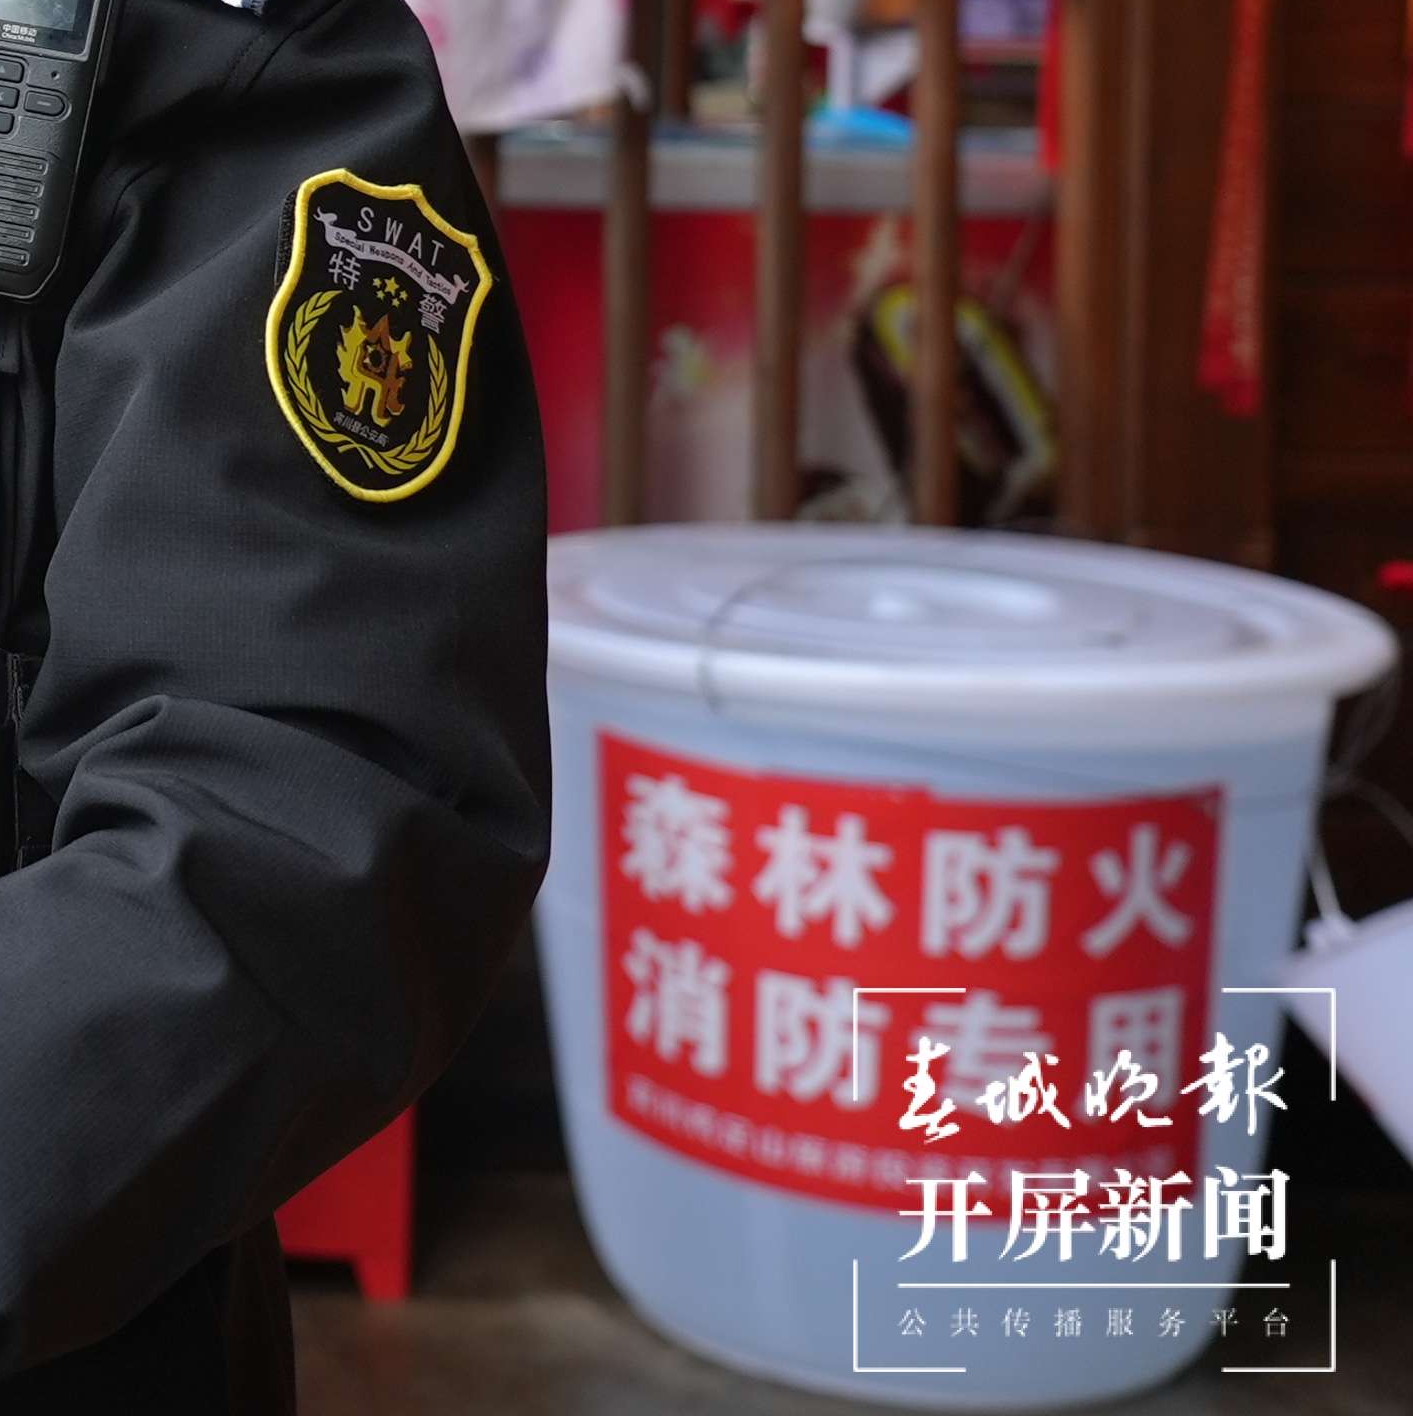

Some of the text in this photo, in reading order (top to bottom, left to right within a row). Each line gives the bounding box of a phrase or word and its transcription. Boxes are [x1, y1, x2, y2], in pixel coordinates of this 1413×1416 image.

[357, 206, 445, 266] SWAT
[622, 774, 1191, 960] 森林防火
[621, 926, 1187, 1130] 消防专用
